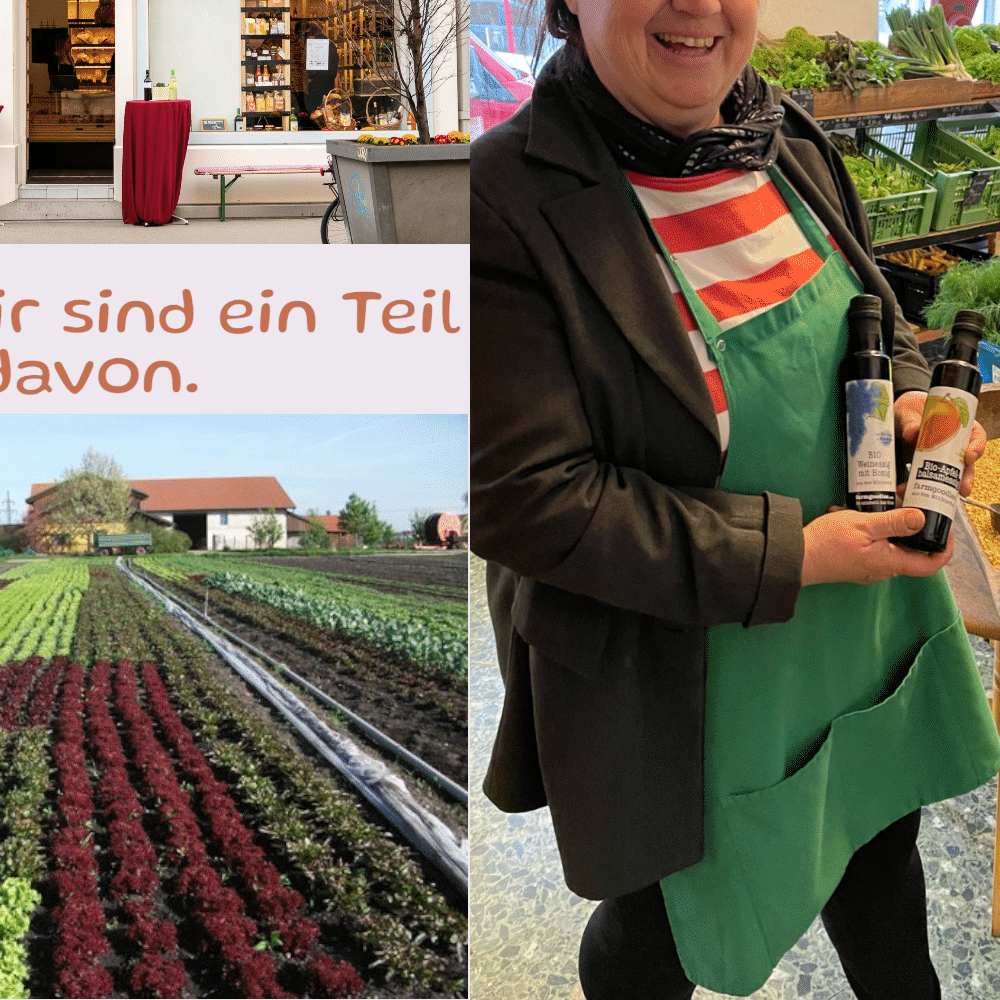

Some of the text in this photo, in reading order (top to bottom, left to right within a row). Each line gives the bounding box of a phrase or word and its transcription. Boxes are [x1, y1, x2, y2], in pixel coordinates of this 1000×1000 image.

[867, 451, 882, 459] BIO
[857, 460, 891, 470] Weinessig
[858, 469, 891, 479] mit Honig
